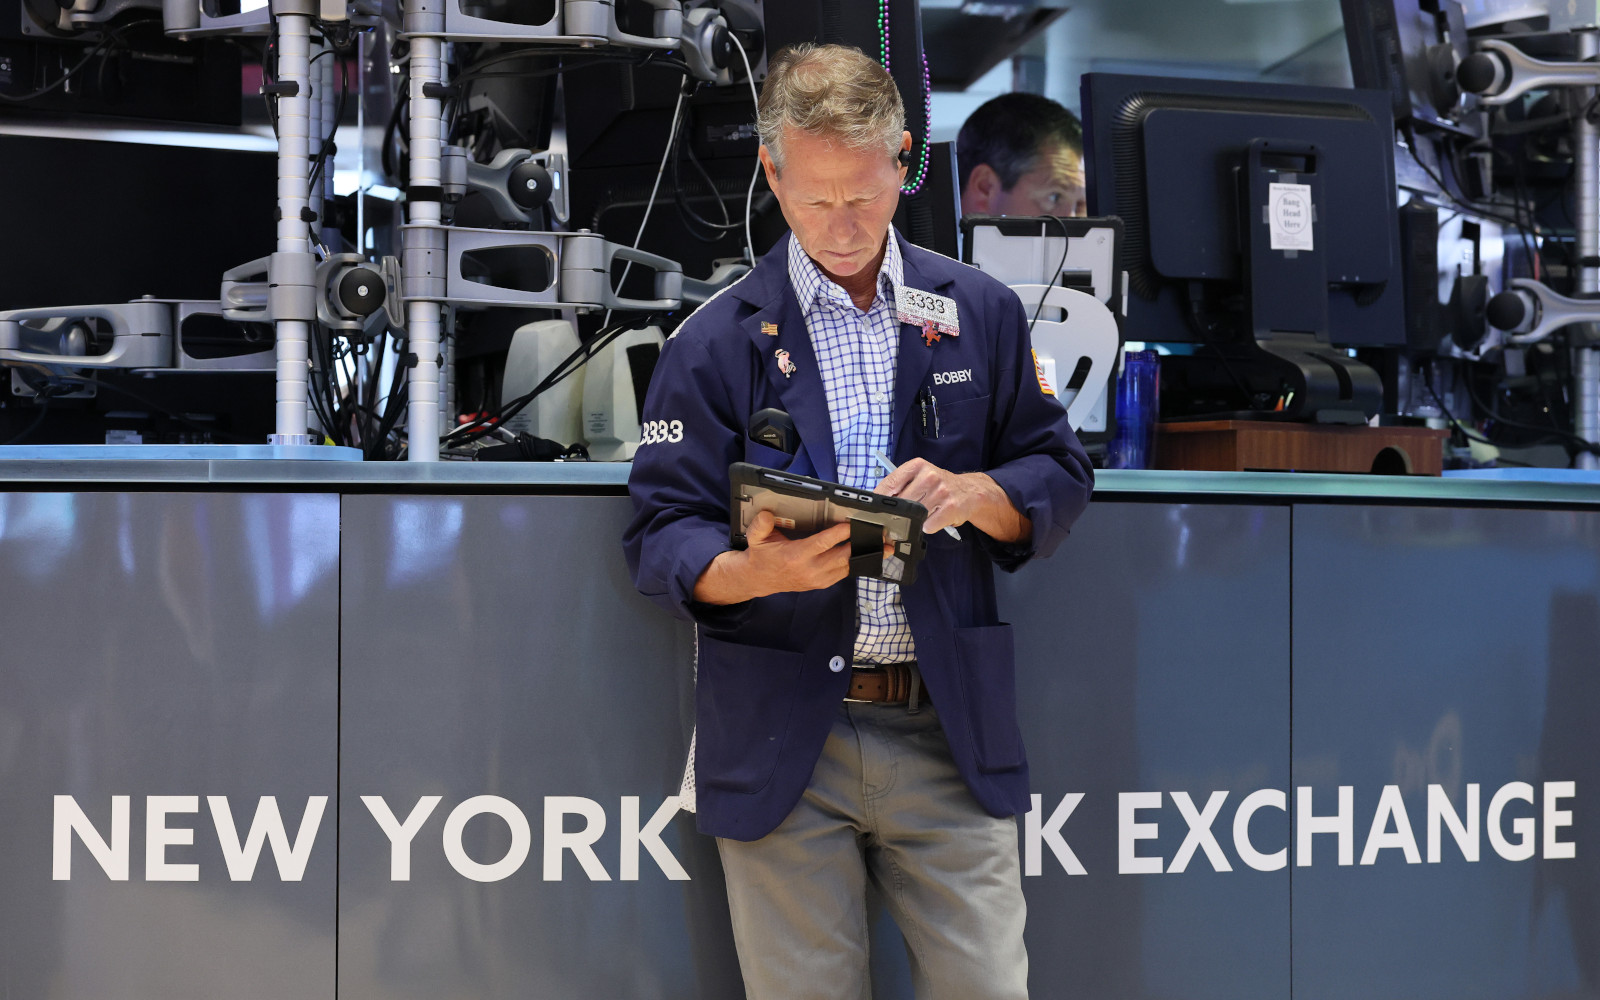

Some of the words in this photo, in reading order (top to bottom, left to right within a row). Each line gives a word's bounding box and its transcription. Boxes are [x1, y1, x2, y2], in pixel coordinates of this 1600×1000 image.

[1282, 198, 1301, 207] Bang
[1282, 209, 1302, 217] Head
[1284, 220, 1301, 228] Here
[905, 290, 946, 314] 3333
[932, 368, 973, 386] BOBBY
[639, 419, 684, 446] 3333
[52, 794, 329, 882] NEW
[360, 794, 692, 883] YORK
[1117, 780, 1576, 875] EXCHANGE
